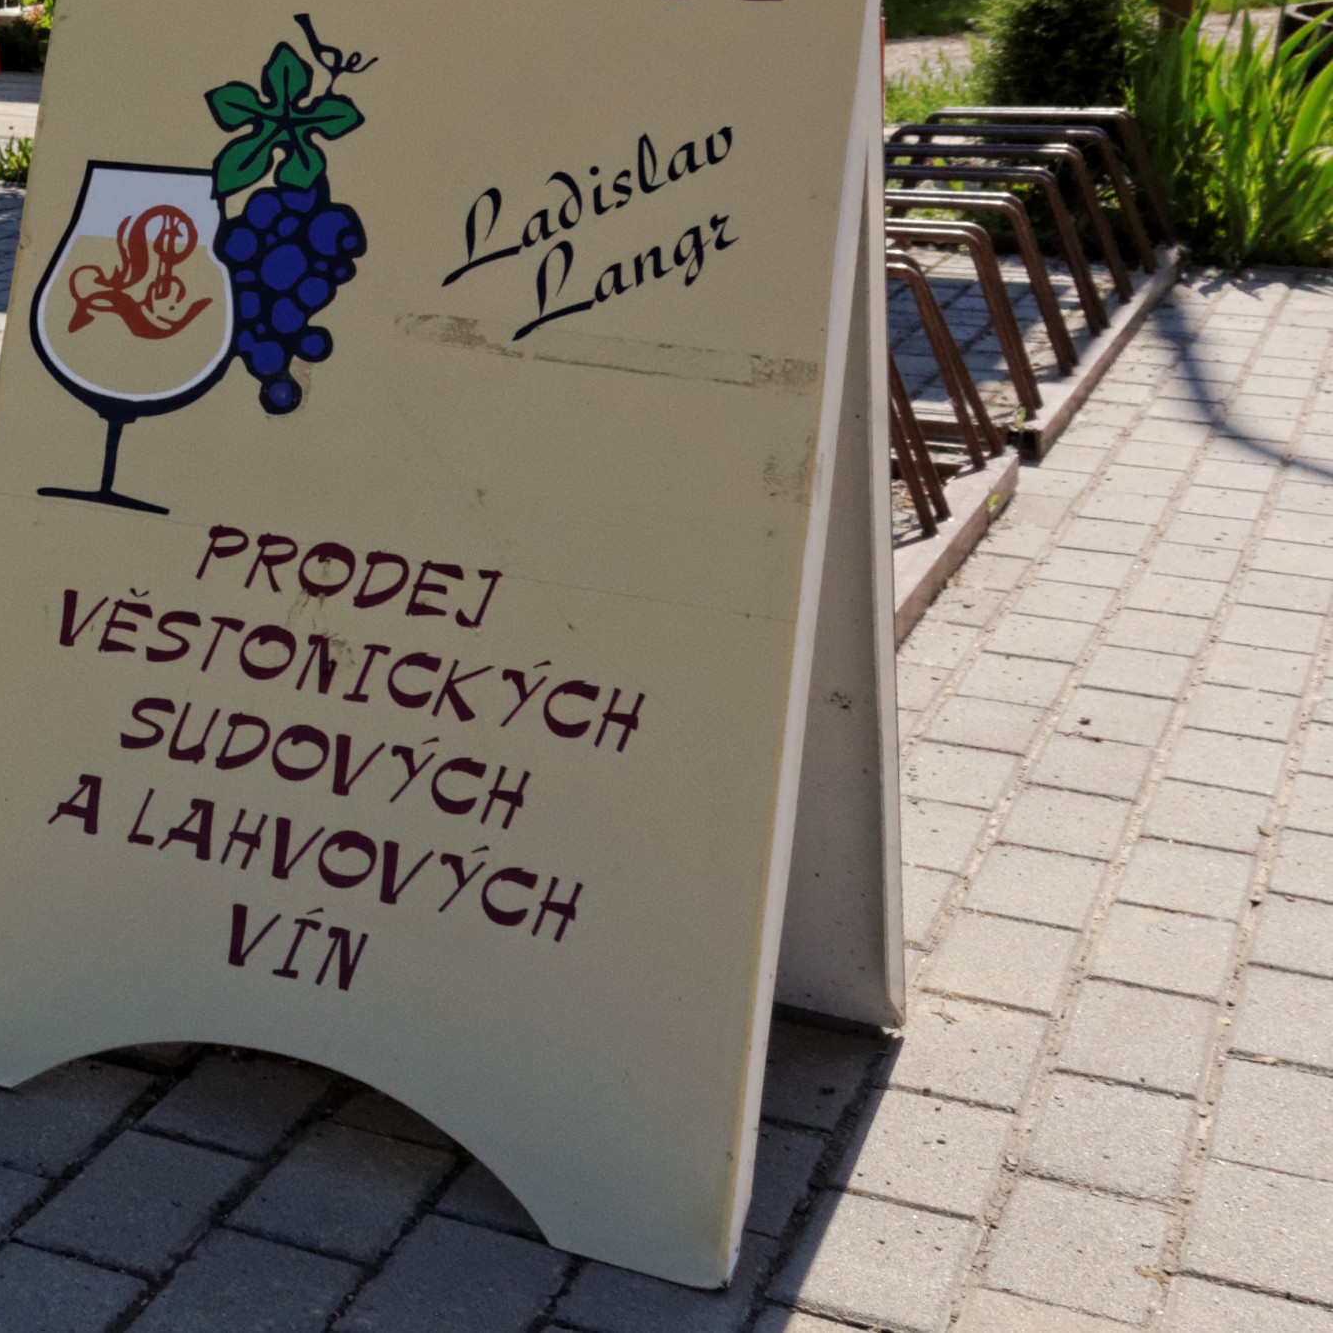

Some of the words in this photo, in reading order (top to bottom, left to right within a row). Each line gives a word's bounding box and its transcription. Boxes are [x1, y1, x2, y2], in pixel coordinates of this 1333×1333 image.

[441, 122, 735, 288] Ladislav
[512, 210, 739, 342] Langr
[194, 523, 504, 629] PRODEJ
[57, 586, 647, 753] VĚSTONICKÝCH
[119, 695, 532, 830] SUDOVÝCH
[47, 772, 103, 836] A
[127, 787, 585, 943] LAHVOVÝCH
[226, 901, 370, 992] VÍN
